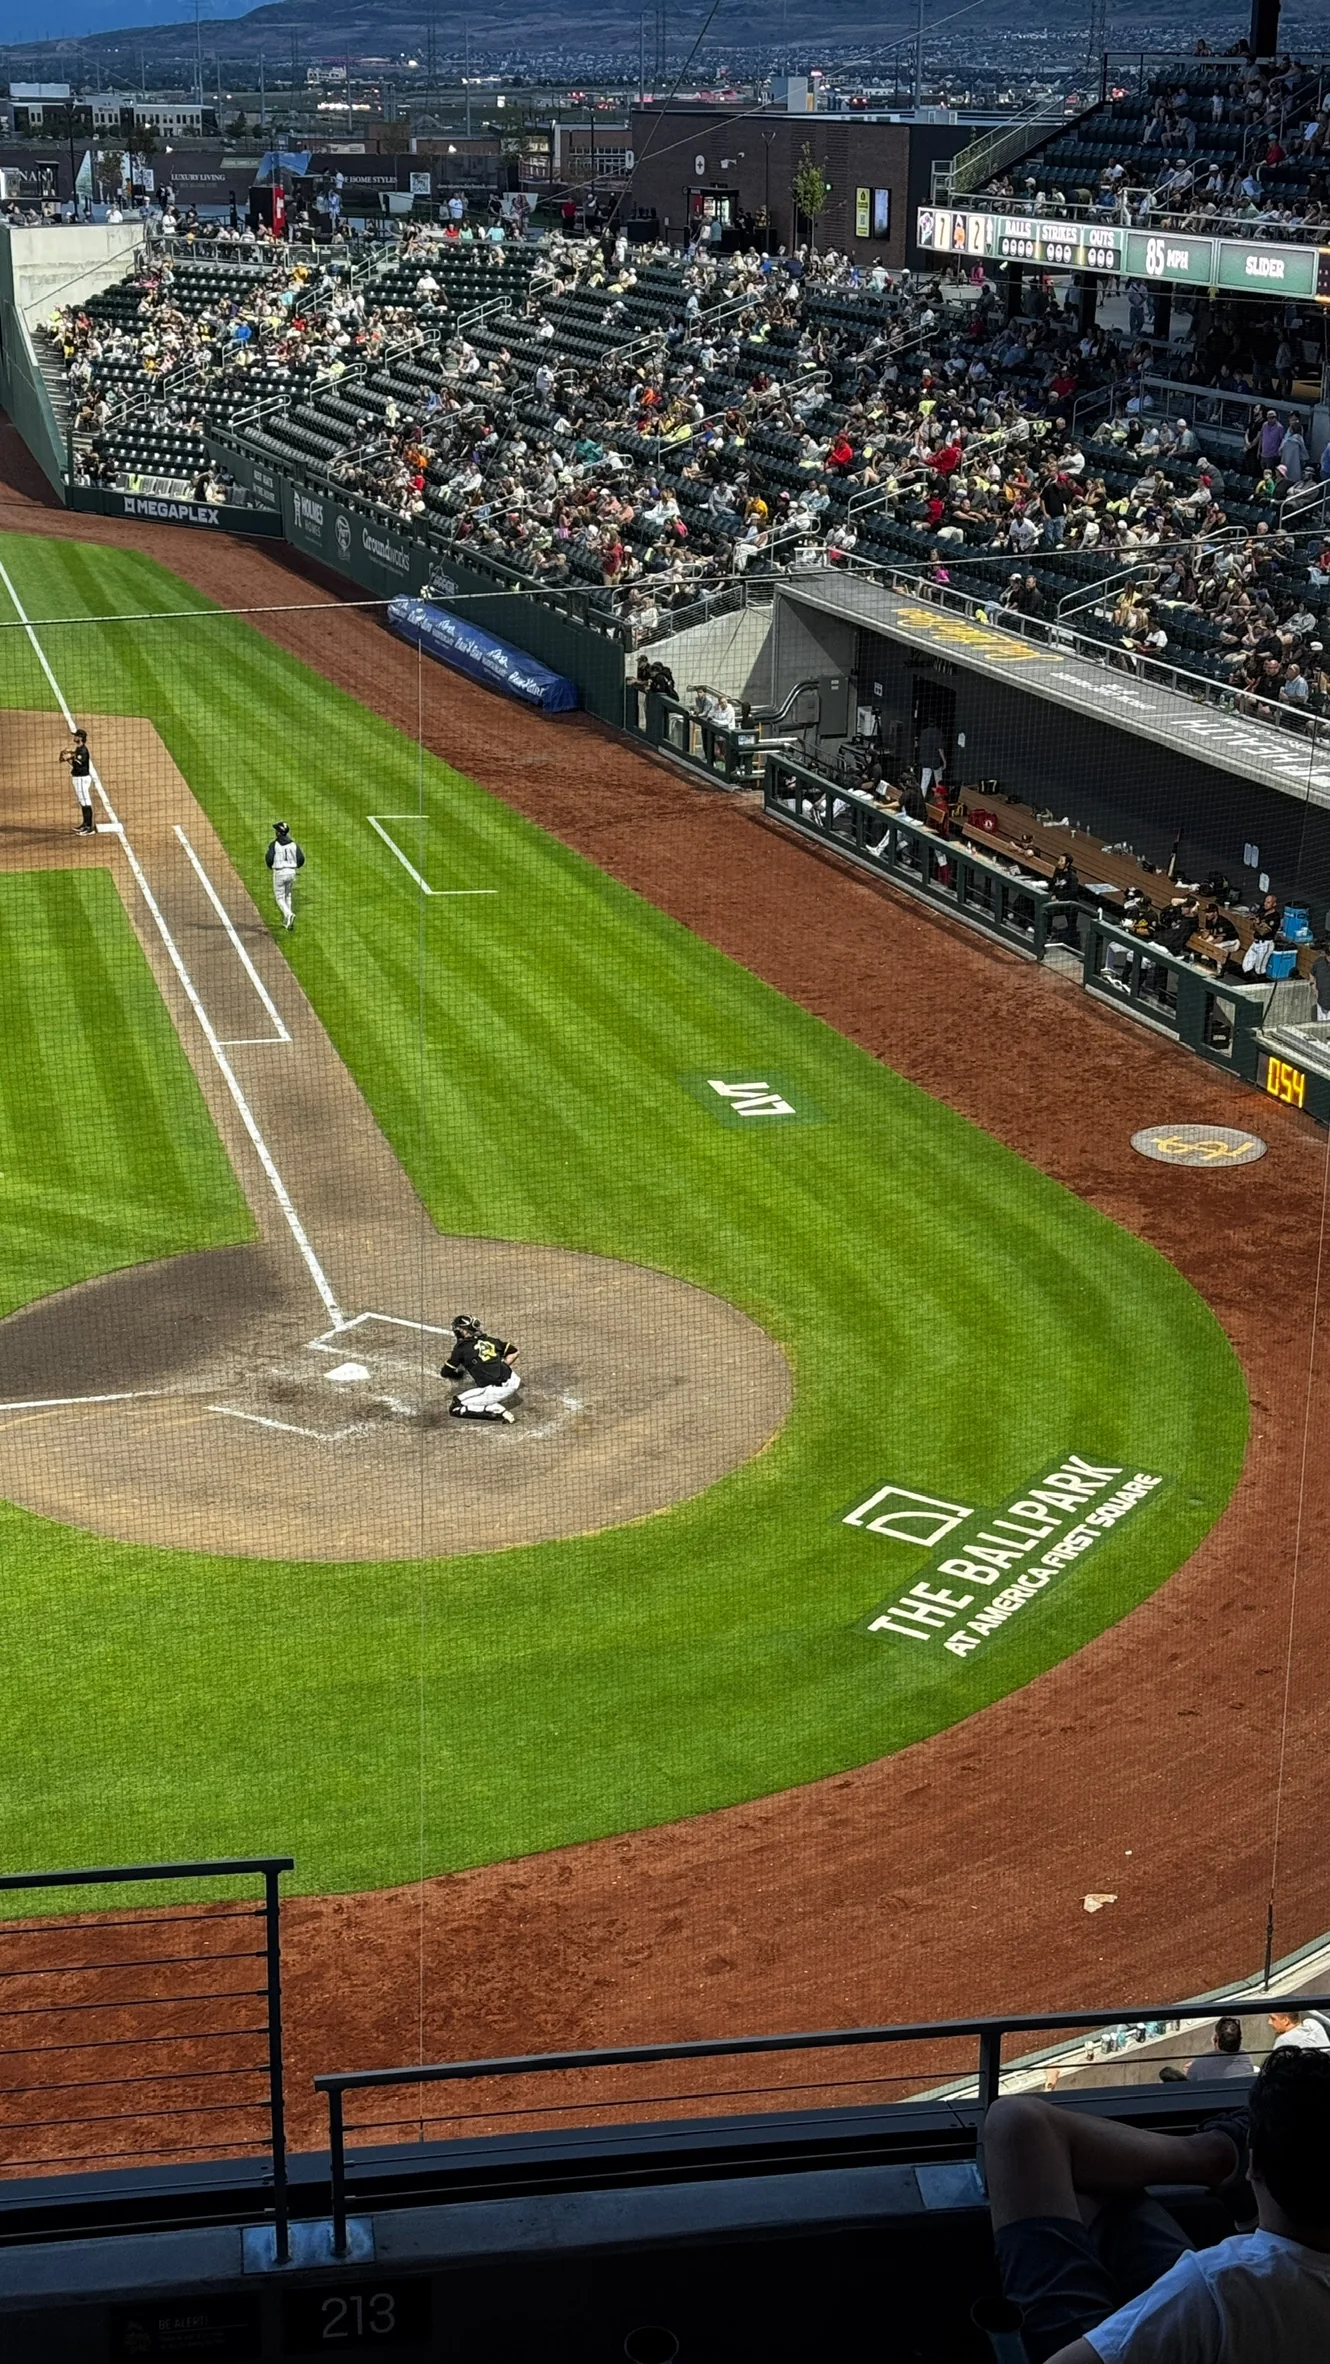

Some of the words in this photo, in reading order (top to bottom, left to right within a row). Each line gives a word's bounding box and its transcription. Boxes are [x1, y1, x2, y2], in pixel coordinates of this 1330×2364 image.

[350, 176, 372, 184] HOME
[372, 176, 398, 184] STYLES
[1005, 220, 1032, 238] BALLS
[1041, 224, 1078, 244] STRIKES
[1089, 230, 1115, 247] OUTS
[1146, 238, 1166, 276] 85
[1166, 249, 1189, 271] MPH
[1245, 255, 1285, 280] SLIDER
[136, 501, 220, 525] MEGAPLEX
[301, 494, 323, 526] HOLMES
[362, 527, 410, 572] Groundworks
[1170, 718, 1311, 763] HEALTH
[1267, 1056, 1305, 1108] 054
[867, 1581, 975, 1640] THE
[937, 1455, 1123, 1586] BALLPARK
[943, 1630, 981, 1658] AT
[966, 1567, 1059, 1636] AMERICA
[1040, 1523, 1101, 1569] FIRST
[1085, 1472, 1162, 1528] SQUARE
[321, 2293, 396, 2339] 213
